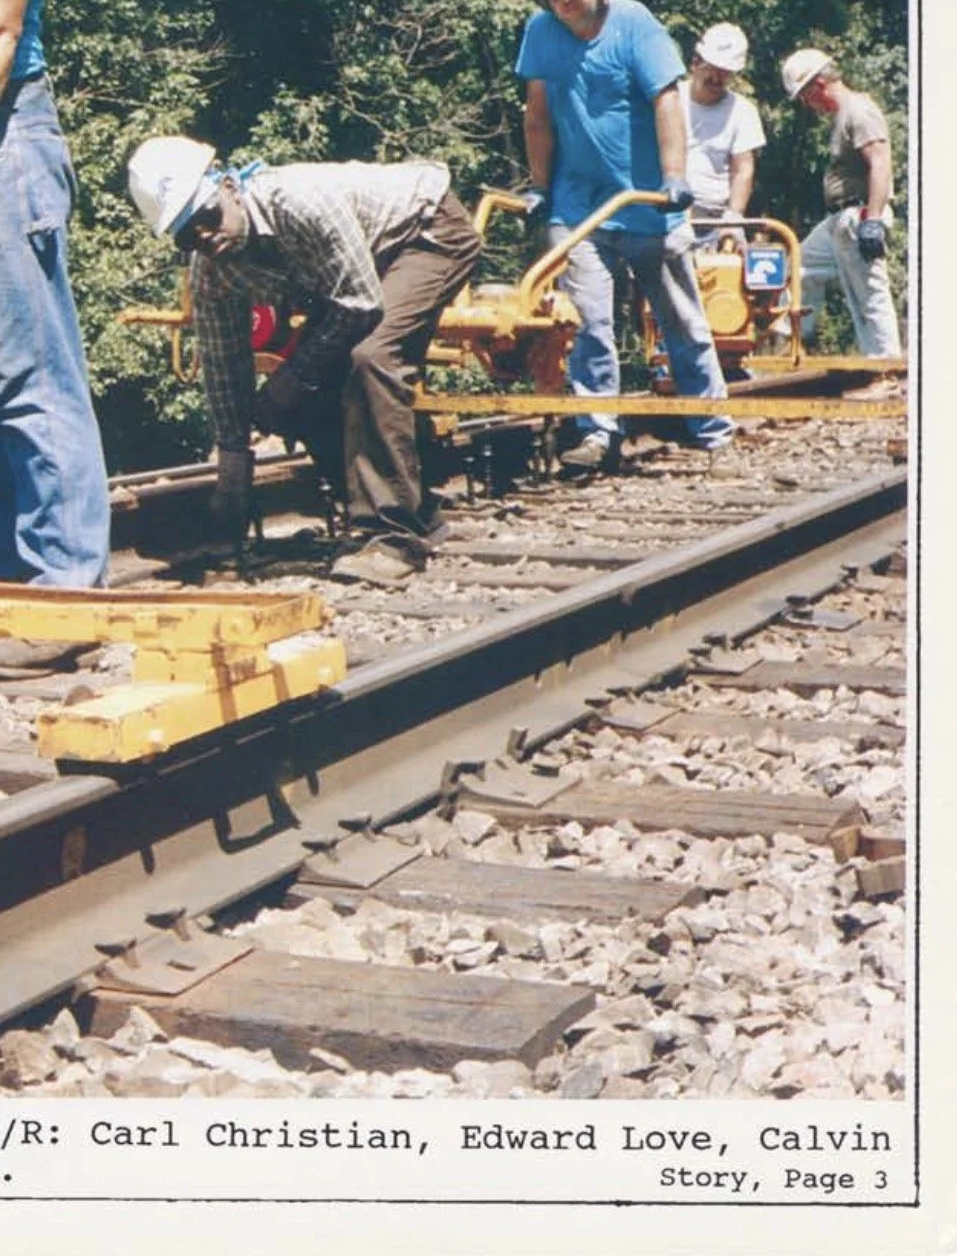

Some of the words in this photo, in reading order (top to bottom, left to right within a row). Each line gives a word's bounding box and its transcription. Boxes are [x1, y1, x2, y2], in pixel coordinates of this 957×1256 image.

[91, 1120, 178, 1146] Carl
[206, 1120, 428, 1155] Christian,
[461, 1124, 597, 1150] Edward
[622, 1126, 728, 1157] Love,
[759, 1123, 891, 1151] Calvin
[660, 1167, 760, 1193] Story,
[784, 1169, 854, 1194] Page
[875, 1170, 889, 1190] 3
